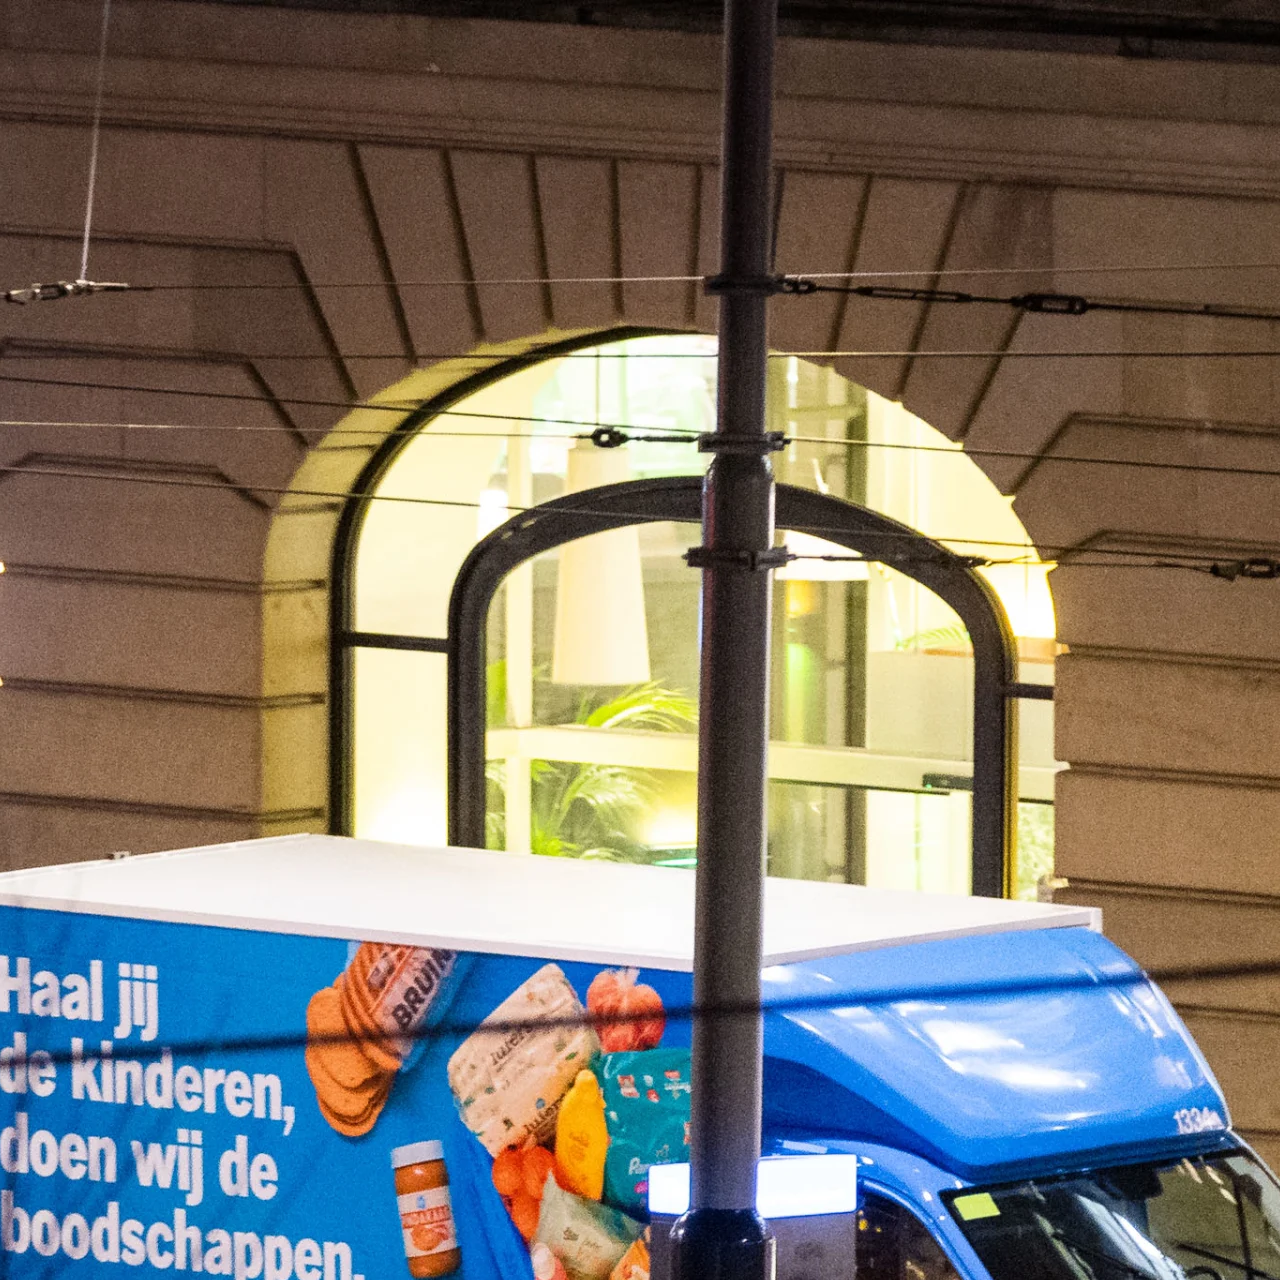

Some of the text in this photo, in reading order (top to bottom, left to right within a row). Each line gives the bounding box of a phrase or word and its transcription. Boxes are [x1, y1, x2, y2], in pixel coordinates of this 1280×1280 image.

[113, 962, 159, 1042] jij
[71, 1037, 296, 1136] kinderen,
[131, 1128, 203, 1207] wij
[219, 1135, 279, 1201] de
